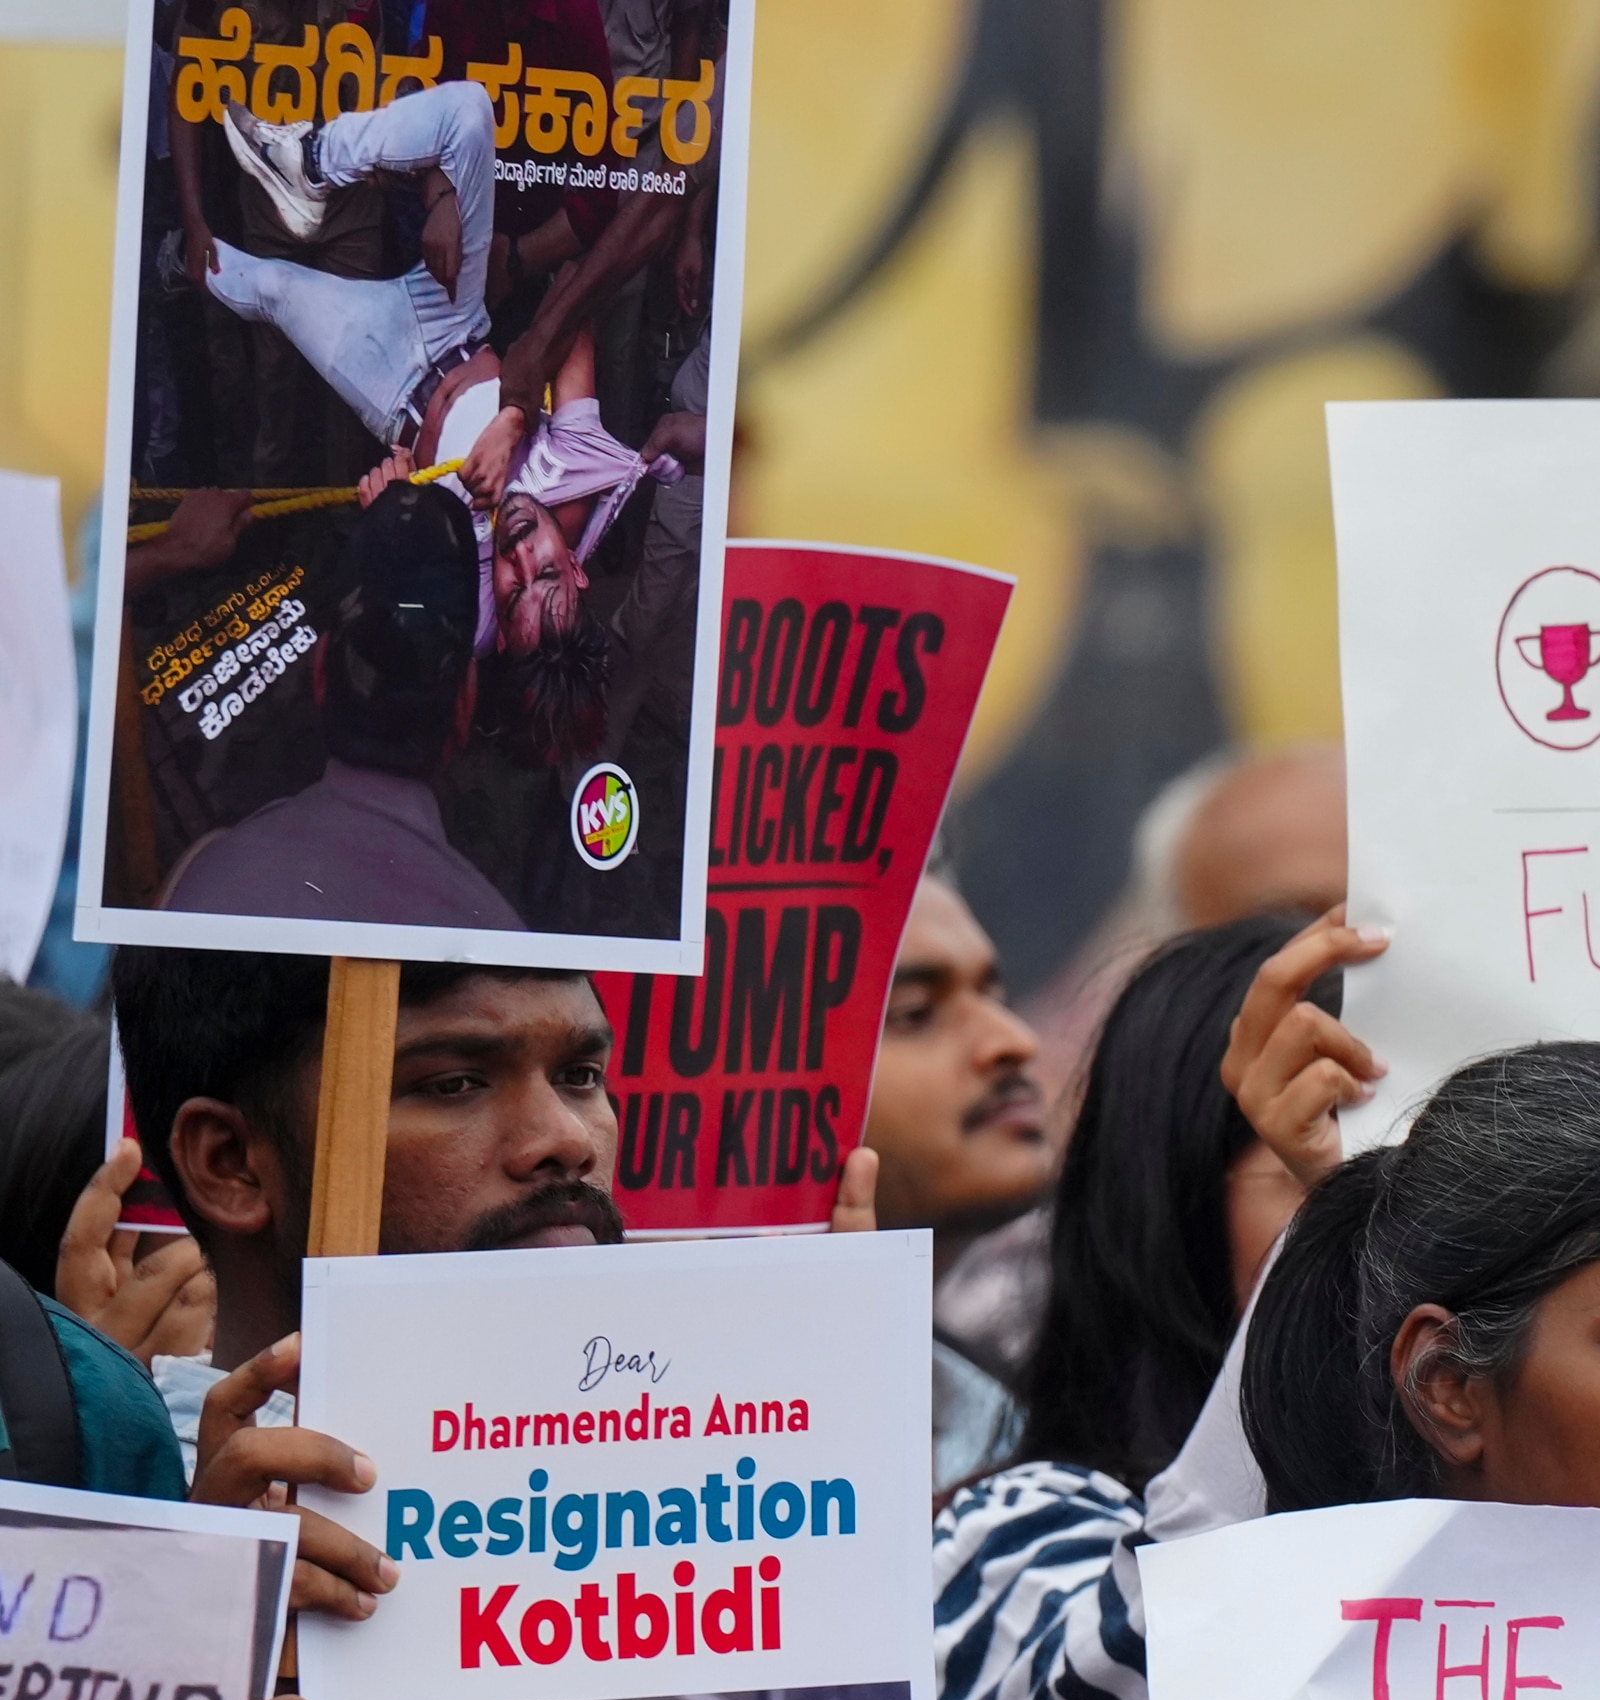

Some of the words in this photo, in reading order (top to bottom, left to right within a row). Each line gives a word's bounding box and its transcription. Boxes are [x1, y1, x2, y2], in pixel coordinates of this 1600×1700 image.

[569, 162, 606, 189] ಮೇಲೆ
[609, 168, 639, 191] ಲಾಠಿ
[717, 597, 945, 734] BOOTS
[580, 790, 628, 835] KVS
[708, 743, 899, 878] LICKED,
[621, 905, 863, 1078] TOMP
[607, 1090, 702, 1191] UR
[578, 1336, 672, 1394] Dear
[430, 1392, 692, 1454] Dharmendra
[703, 1391, 811, 1439] Anna
[384, 1456, 857, 1571] Resignation
[458, 1556, 783, 1669] Kotbidi
